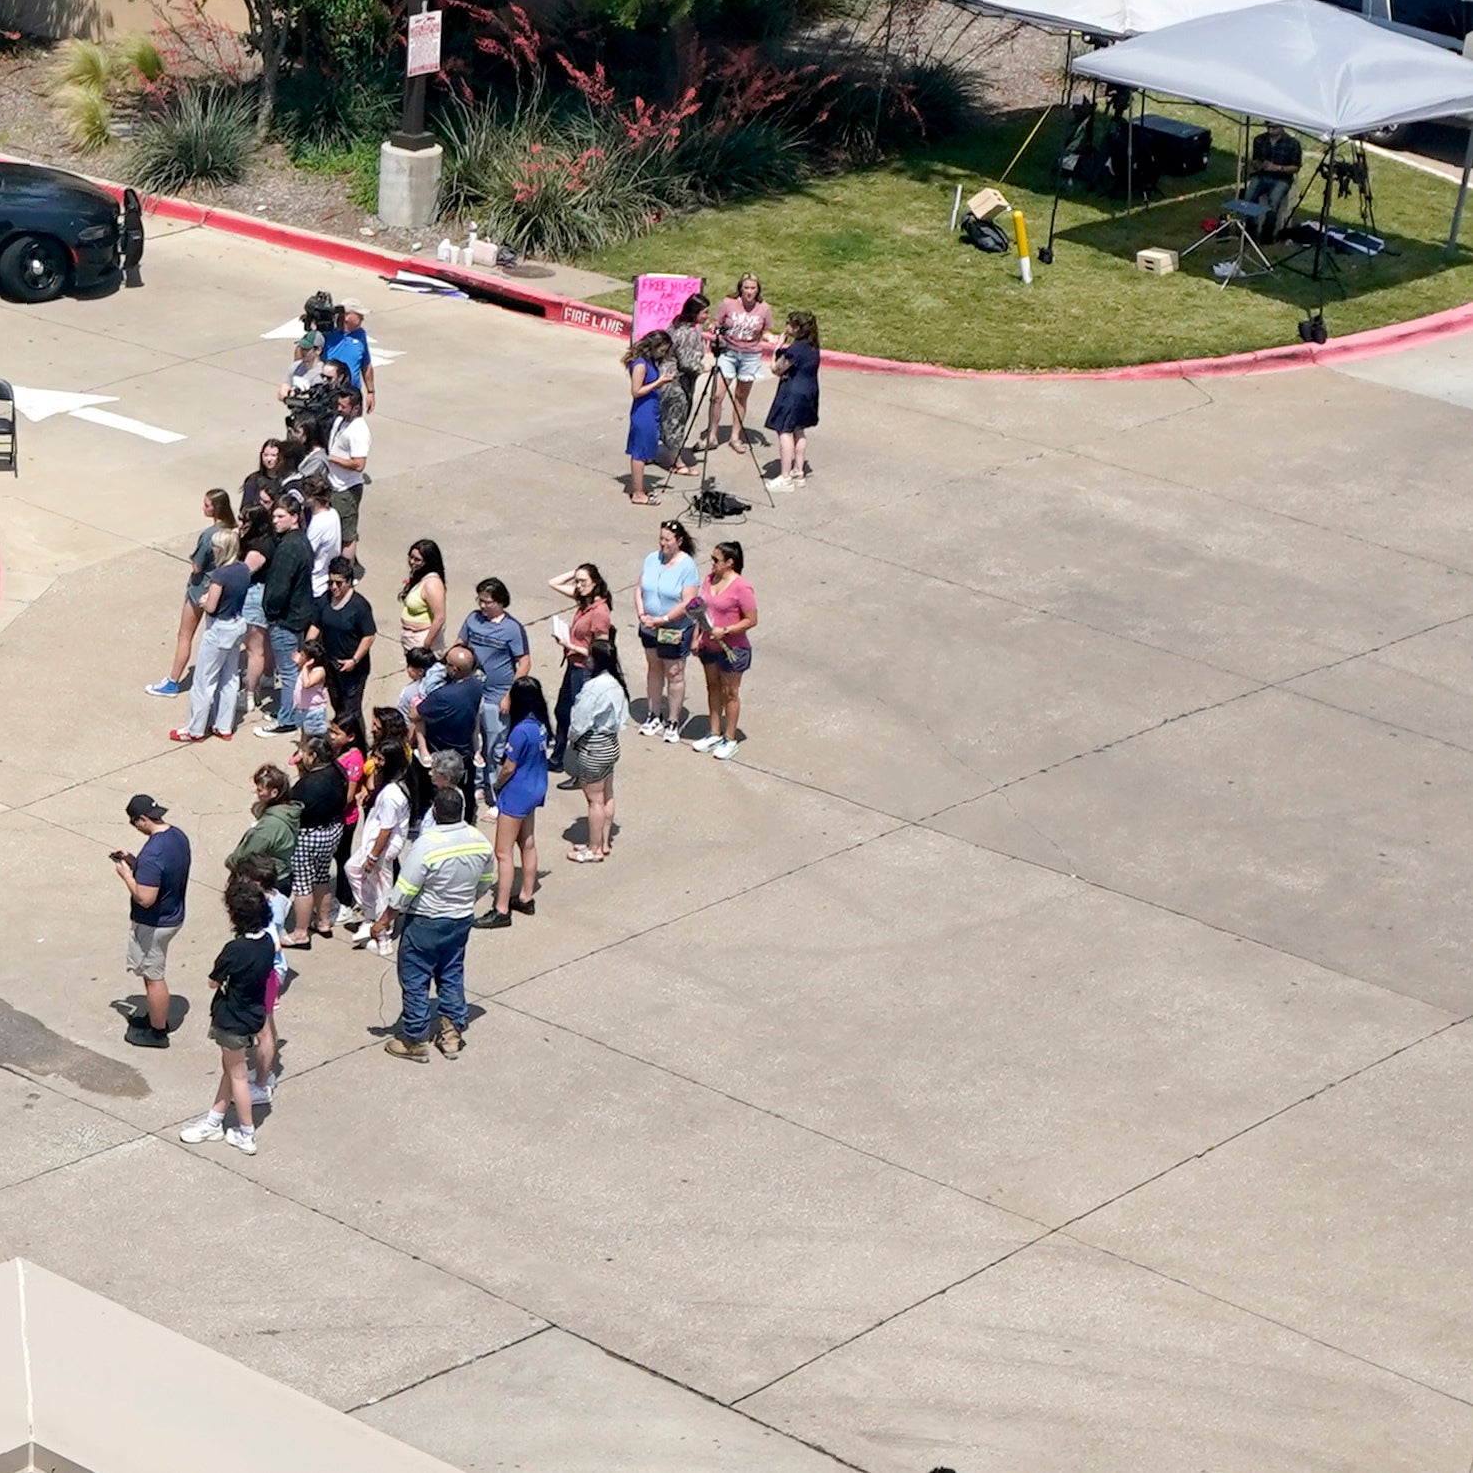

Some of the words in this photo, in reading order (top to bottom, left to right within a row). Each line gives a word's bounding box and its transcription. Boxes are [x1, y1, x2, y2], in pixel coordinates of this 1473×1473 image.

[641, 279, 667, 291] FREE
[563, 307, 590, 326] FIRE
[592, 316, 624, 335] LANE
